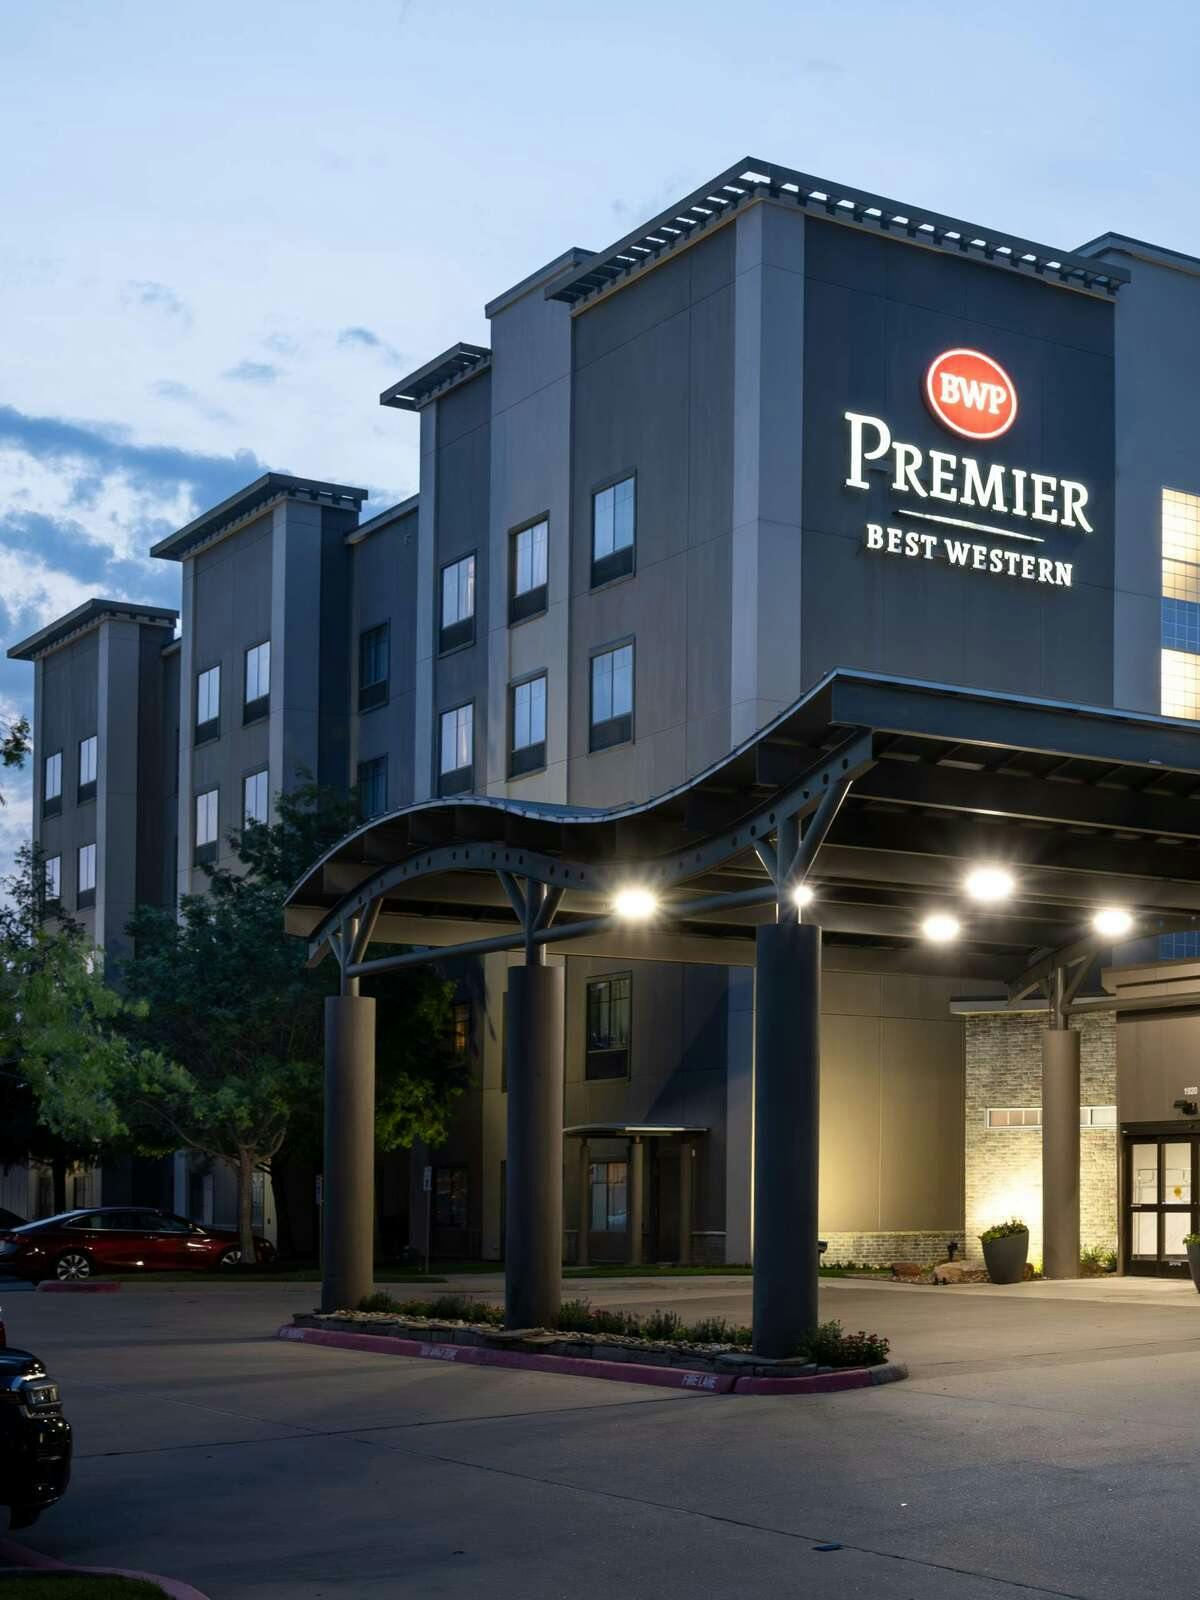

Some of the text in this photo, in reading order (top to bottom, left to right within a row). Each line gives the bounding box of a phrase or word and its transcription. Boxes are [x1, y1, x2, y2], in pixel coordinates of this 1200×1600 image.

[940, 373, 1006, 414] BWP
[845, 411, 1093, 533] PREMIER
[867, 523, 1073, 586] BEST WESTERN
